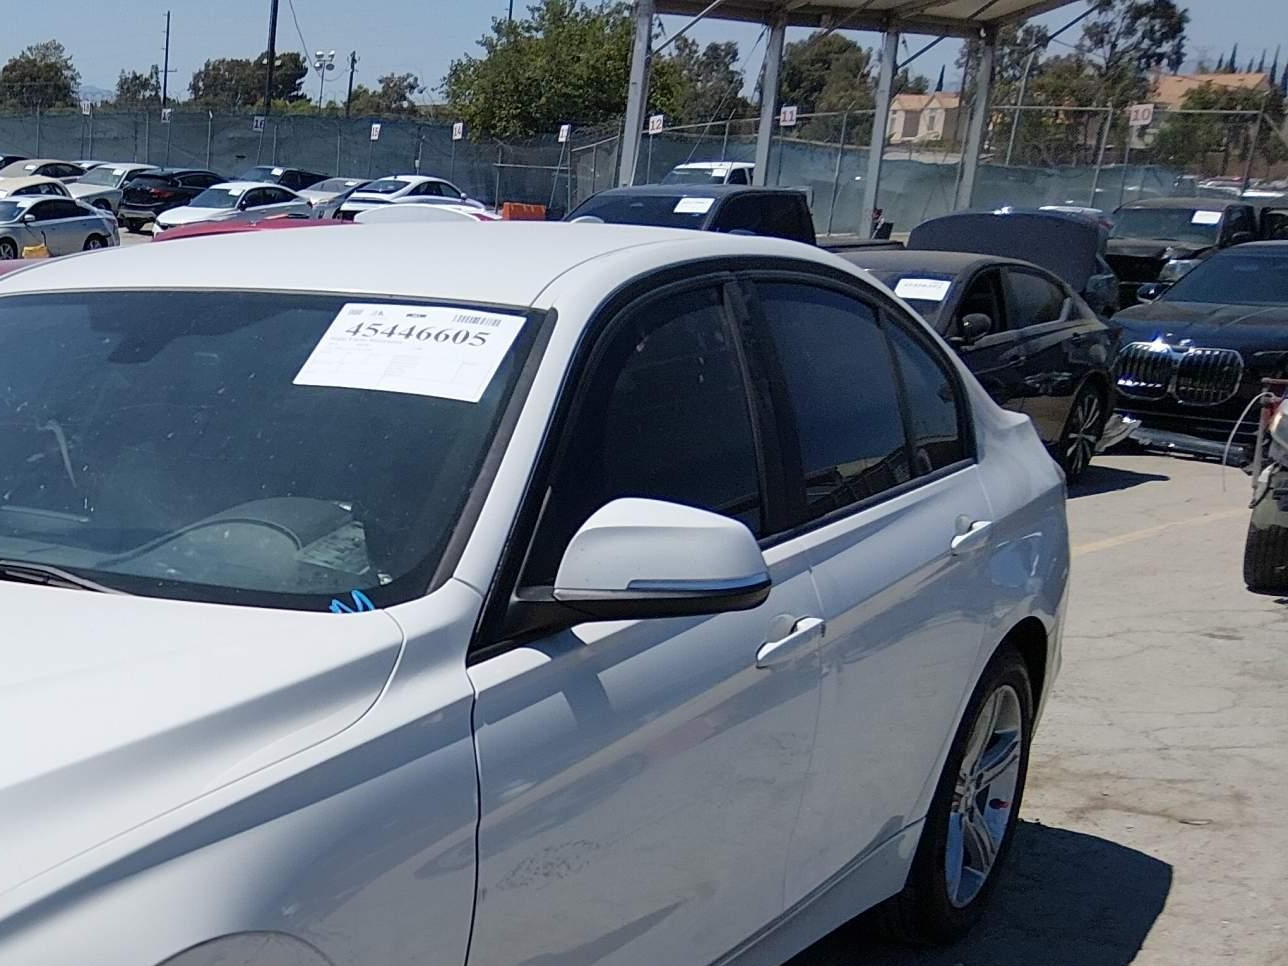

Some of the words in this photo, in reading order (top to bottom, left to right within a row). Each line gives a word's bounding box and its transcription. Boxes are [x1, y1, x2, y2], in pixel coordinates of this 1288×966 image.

[782, 110, 795, 122] 11
[1129, 108, 1150, 121] 10
[650, 119, 662, 132] 12
[345, 321, 491, 347] 45446605
